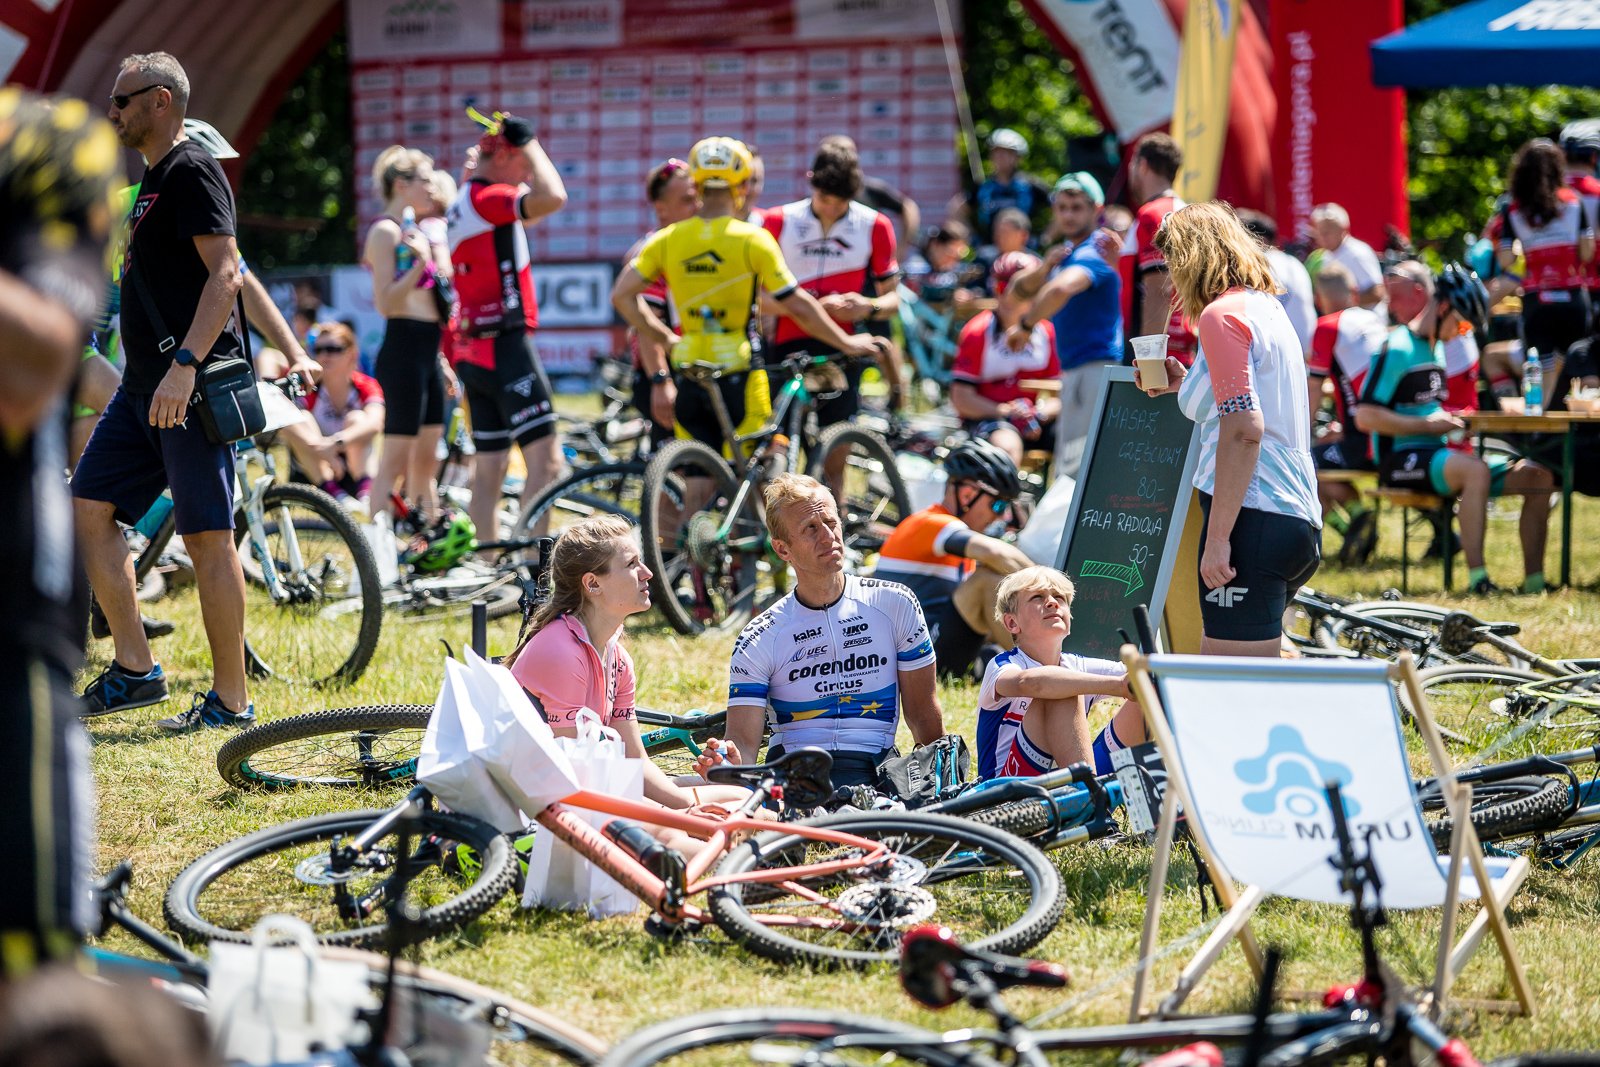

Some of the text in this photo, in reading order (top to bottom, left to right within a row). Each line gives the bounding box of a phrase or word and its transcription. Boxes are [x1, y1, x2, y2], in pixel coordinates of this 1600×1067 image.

[1081, 509, 1162, 536] FALA RADIOWA
[1205, 586, 1248, 608] 4F
[793, 627, 822, 642] kalas
[807, 645, 828, 656] UEC
[814, 679, 863, 693] Circus
